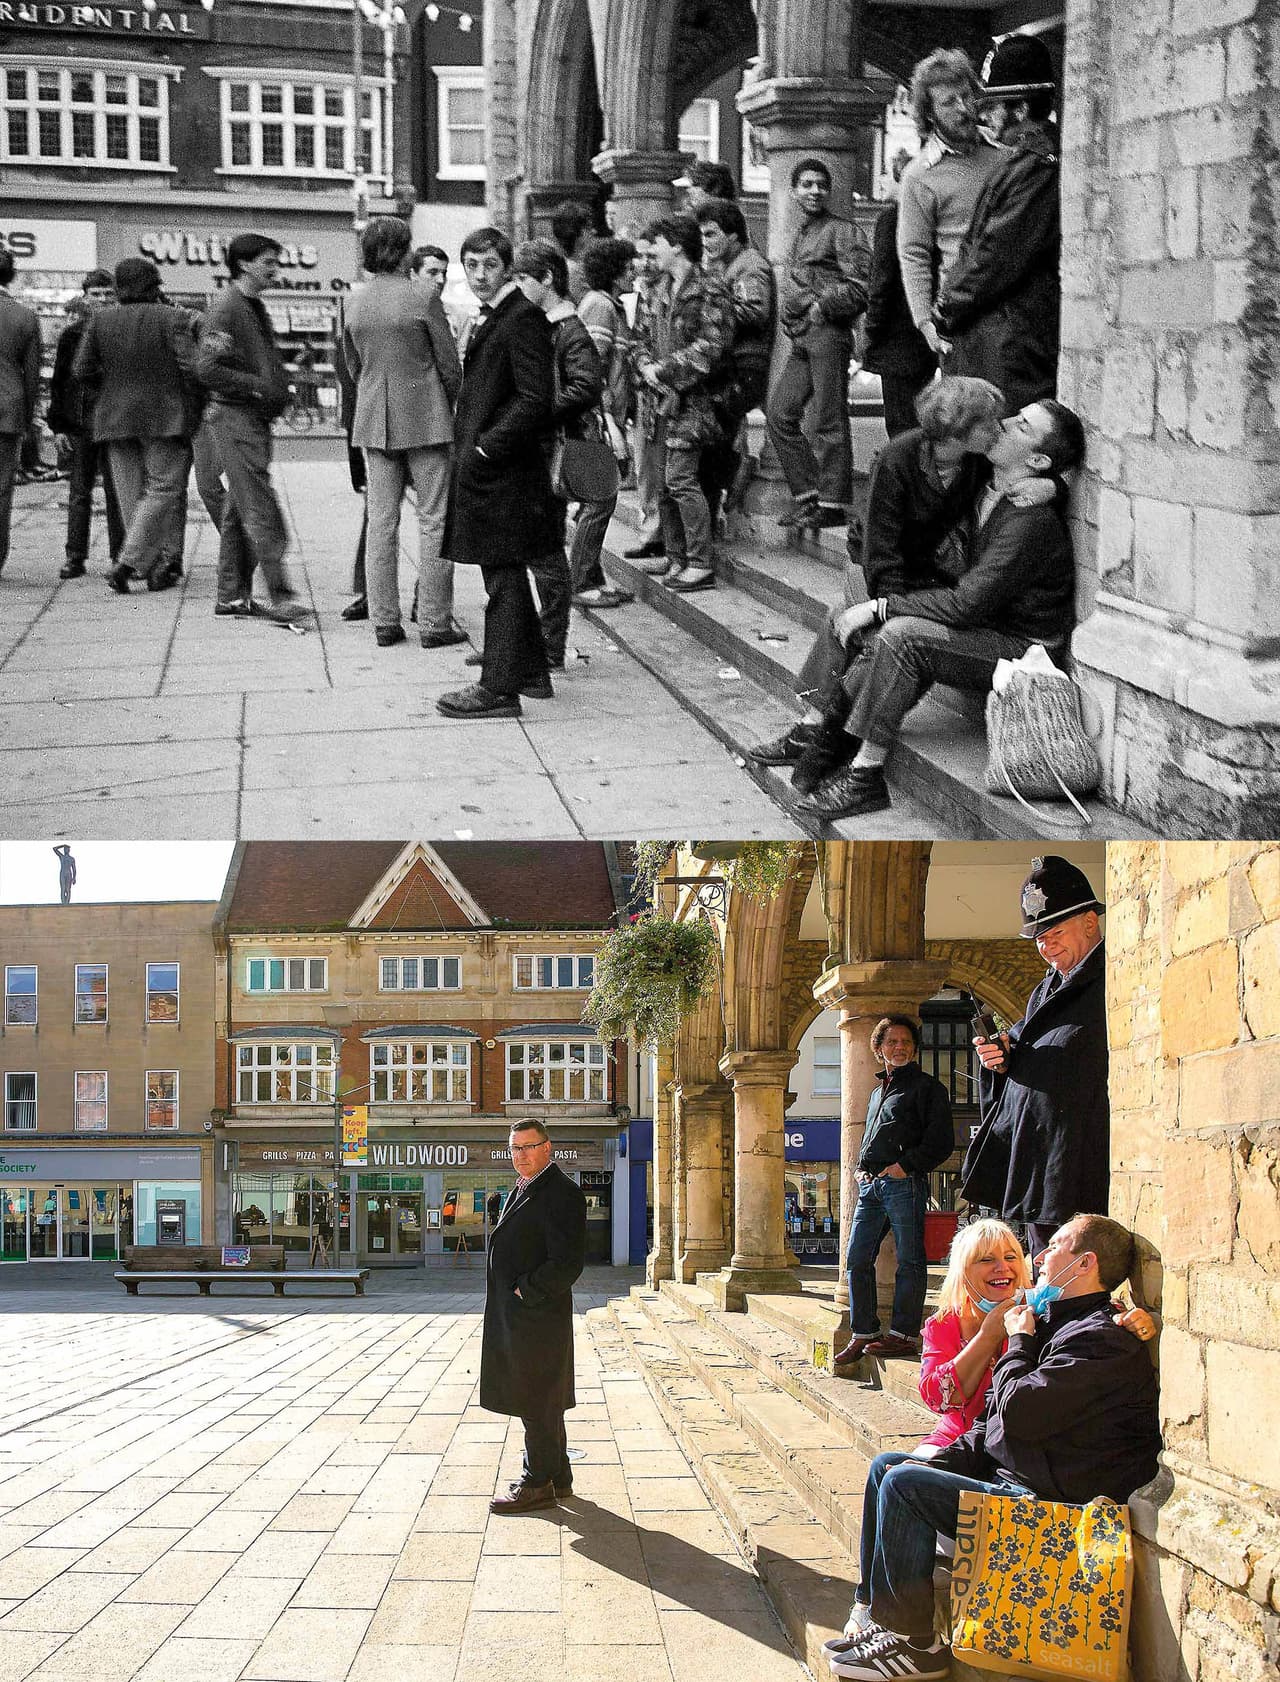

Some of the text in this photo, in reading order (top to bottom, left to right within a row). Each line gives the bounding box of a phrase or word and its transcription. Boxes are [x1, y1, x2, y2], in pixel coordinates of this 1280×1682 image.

[262, 1151, 288, 1160] GRILLS
[296, 1151, 317, 1160] PIZZA
[372, 1144, 468, 1166] WILDWOOD
[554, 1150, 578, 1160] PASTA
[581, 1173, 612, 1185] REED
[1039, 1649, 1113, 1678] seasalt
